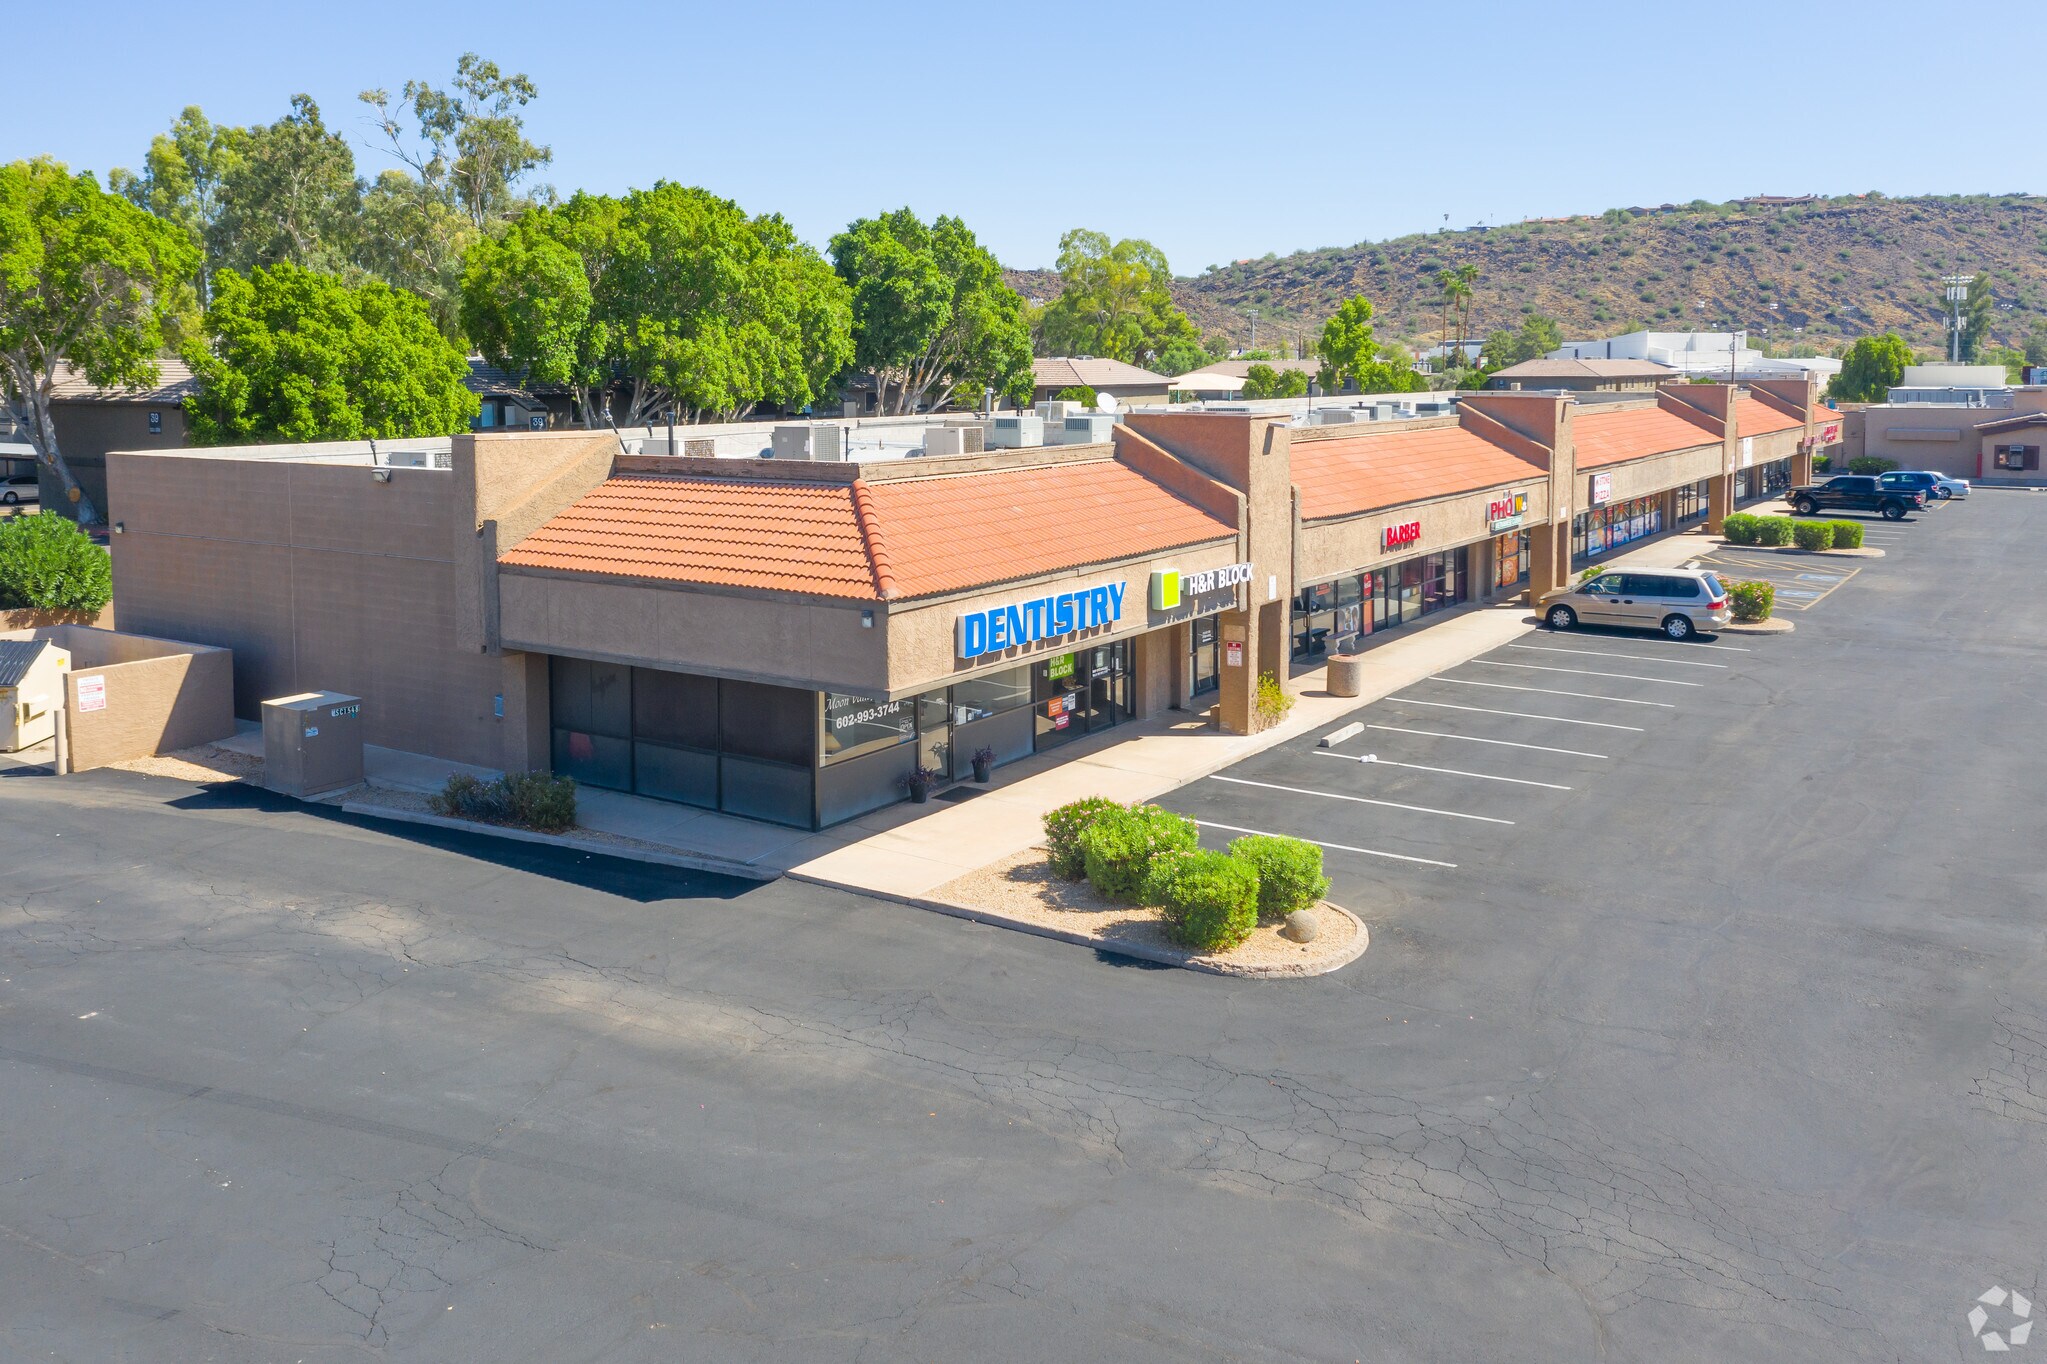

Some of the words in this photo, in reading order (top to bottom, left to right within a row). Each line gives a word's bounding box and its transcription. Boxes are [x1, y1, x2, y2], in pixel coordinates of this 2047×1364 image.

[1386, 521, 1421, 546] BARBER
[1189, 570, 1214, 595] H&R
[1218, 563, 1254, 589] BLOCK
[962, 581, 1127, 659] DENTISTRY
[1050, 655, 1065, 668] H&R
[1050, 663, 1073, 678] BLOCK
[835, 701, 900, 729] 602-993-3744
